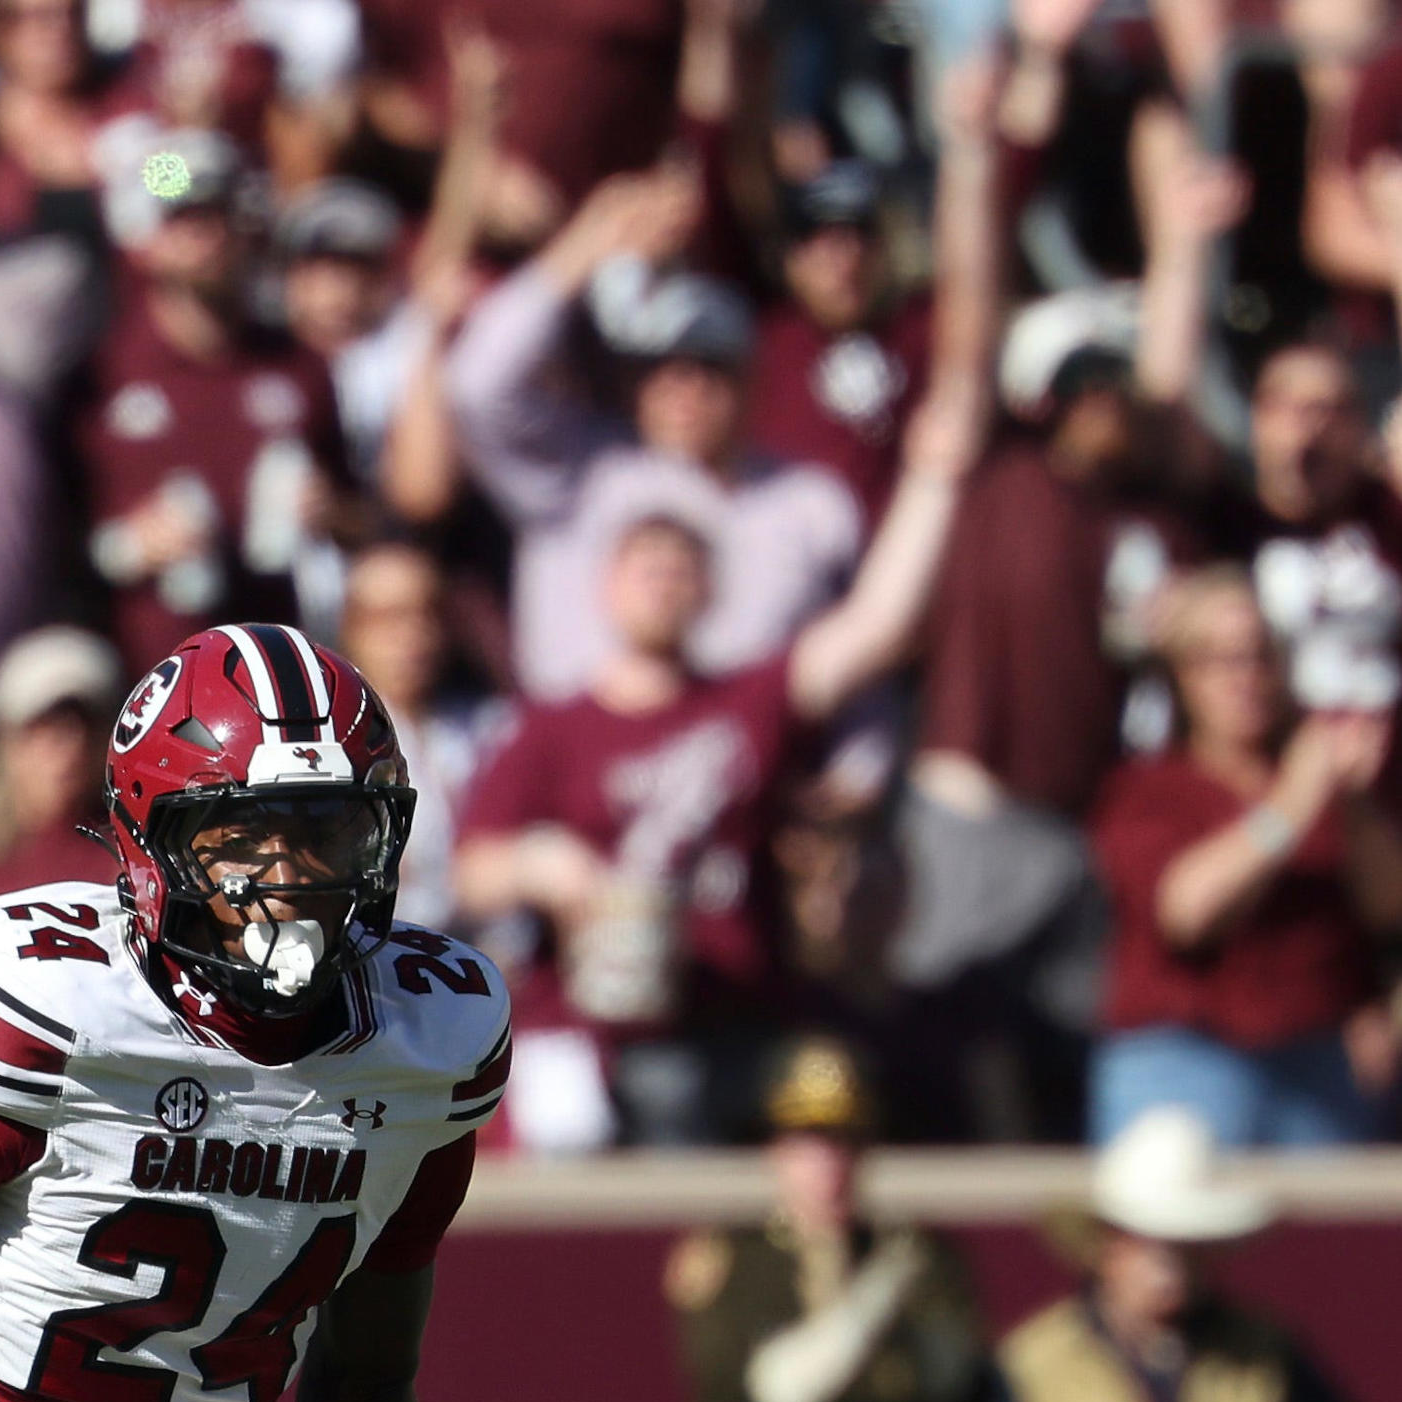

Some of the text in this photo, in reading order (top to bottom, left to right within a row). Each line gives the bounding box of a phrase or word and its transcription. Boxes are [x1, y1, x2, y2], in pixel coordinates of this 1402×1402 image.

[2, 900, 112, 967] 24
[156, 1080, 208, 1130] SEC
[132, 1136, 368, 1203] CAROLINA
